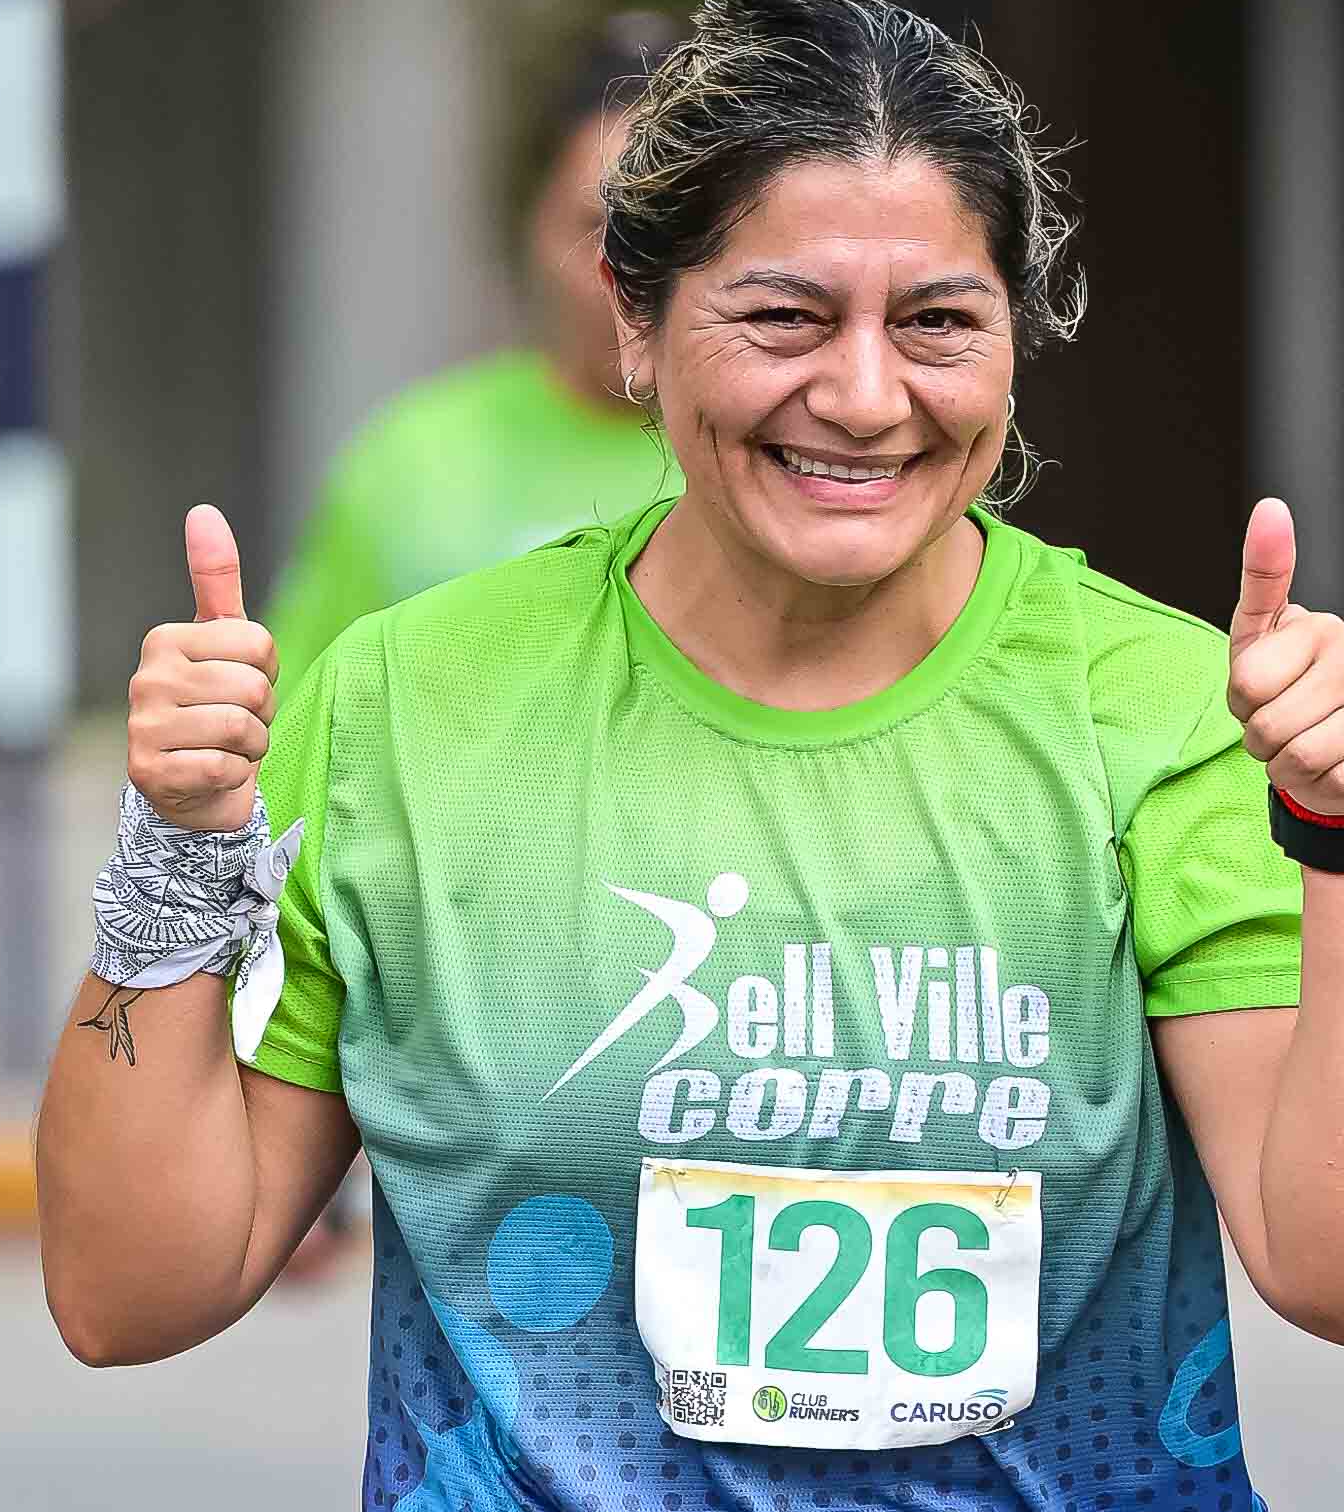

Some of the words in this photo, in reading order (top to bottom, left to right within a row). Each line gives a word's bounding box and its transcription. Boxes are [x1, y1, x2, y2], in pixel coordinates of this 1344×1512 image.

[869, 944, 1052, 1069] Ville
[636, 1067, 1053, 1150] corre
[685, 1193, 991, 1378] 126
[788, 1406, 860, 1422] RUNNER'S
[790, 1392, 828, 1407] CLUB
[889, 1402, 1003, 1423] CARUSO
